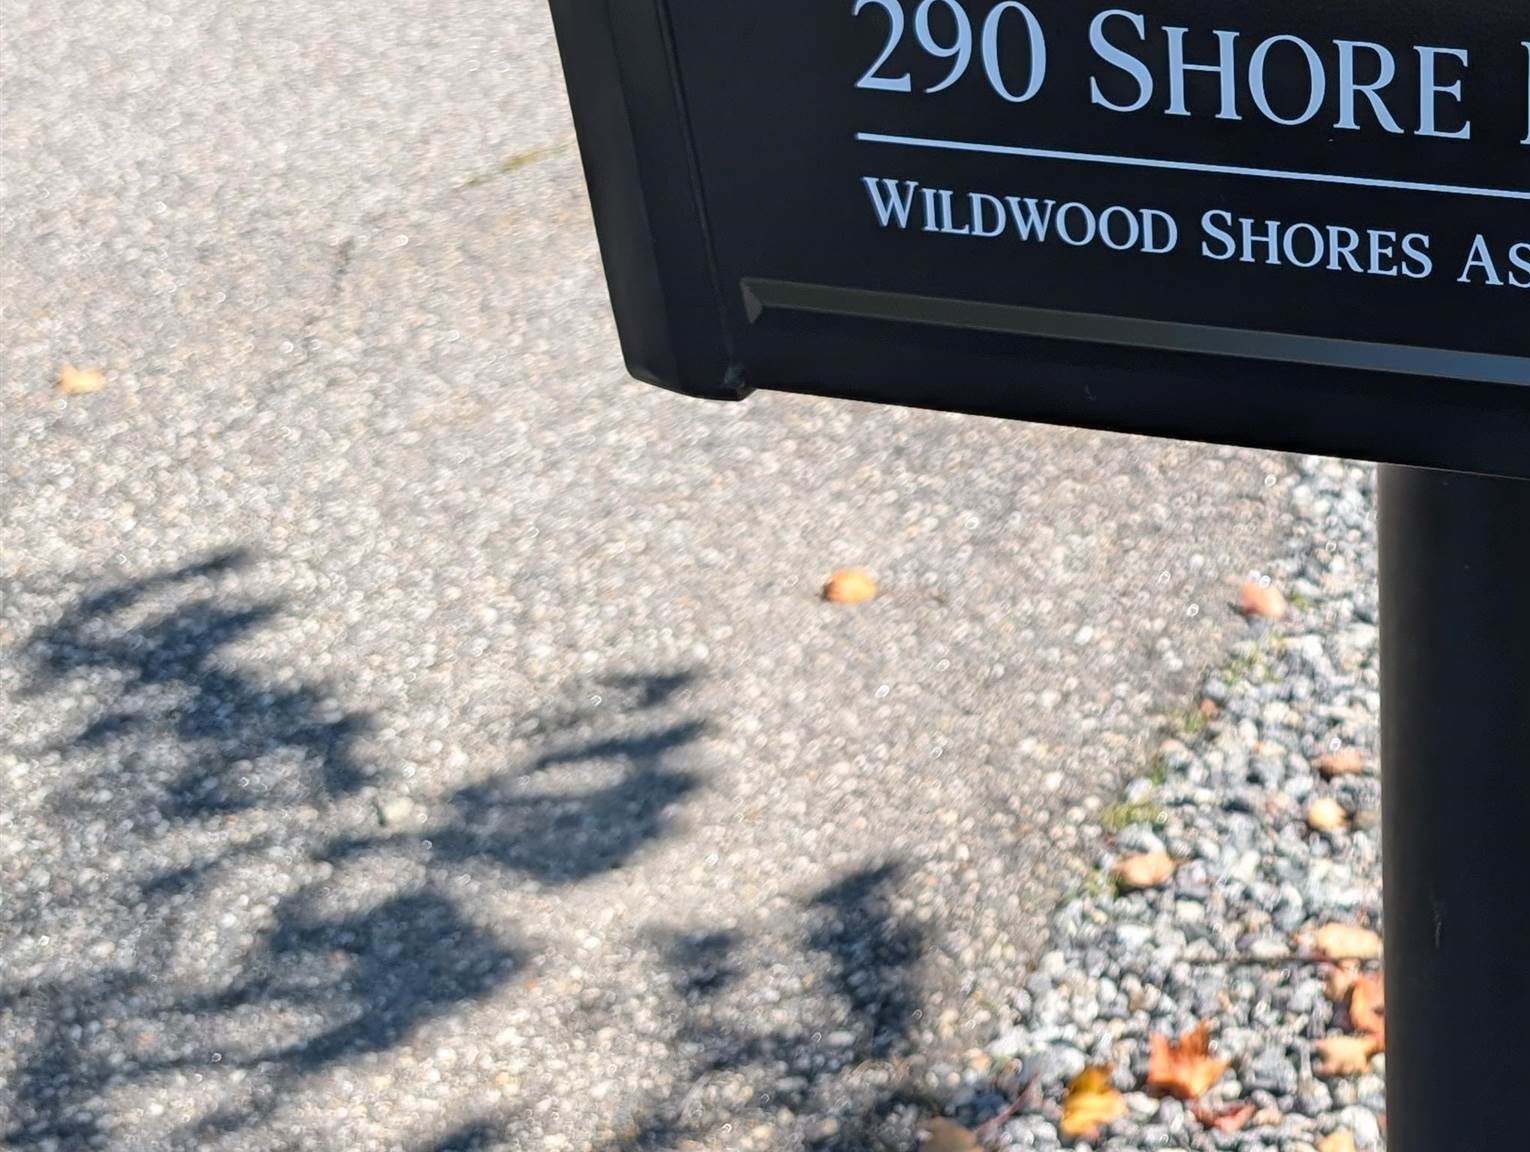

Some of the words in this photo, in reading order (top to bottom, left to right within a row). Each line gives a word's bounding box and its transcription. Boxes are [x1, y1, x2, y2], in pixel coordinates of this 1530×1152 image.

[1089, 9, 1471, 140] SHORE
[862, 176, 1178, 254] WILDWOOD
[1201, 209, 1433, 279] SHORES
